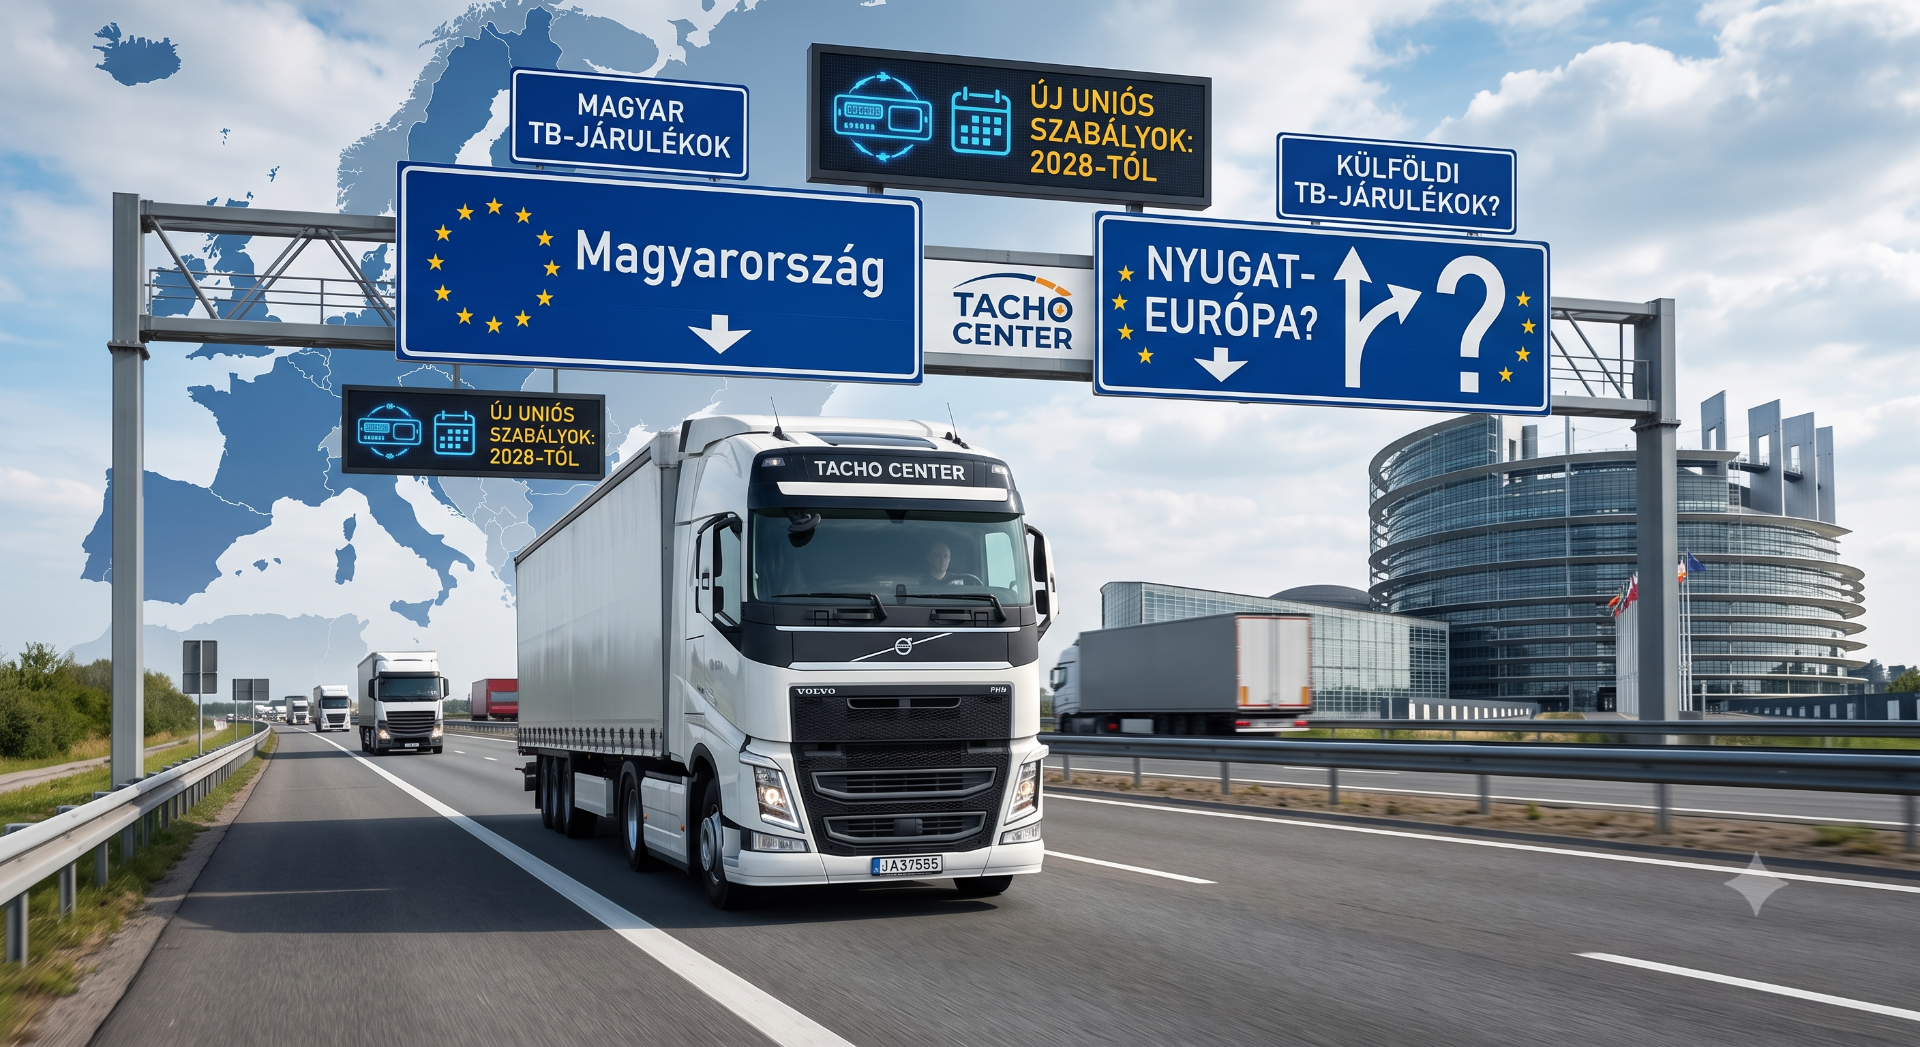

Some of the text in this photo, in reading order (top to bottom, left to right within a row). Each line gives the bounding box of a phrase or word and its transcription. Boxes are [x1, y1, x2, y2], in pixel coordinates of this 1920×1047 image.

[578, 93, 684, 123] MAGYAR
[1031, 79, 1155, 117] ÚJ UNIÓS
[529, 121, 731, 159] TB-JÁRULÉKOK
[1030, 118, 1193, 153] SZABÁLYOK:
[1030, 149, 1158, 182] 2028-TÓL
[1337, 152, 1459, 184] KÜLFÖLDI
[1294, 181, 1500, 217] TB-JÁRULÉKOK?
[577, 229, 884, 299] Magyarország
[1148, 245, 1316, 289] NYUGAT-
[953, 292, 1073, 323] TACHO
[1146, 292, 1318, 341] EURÓPA?
[953, 322, 1073, 350] CENTER
[490, 400, 575, 423] ÚJ UNIÓS
[489, 425, 596, 446] SZABÁLYOK:
[489, 446, 580, 467] 2028-TÓL
[814, 460, 966, 481] TACHO CENTER
[881, 857, 939, 872] JA37555
